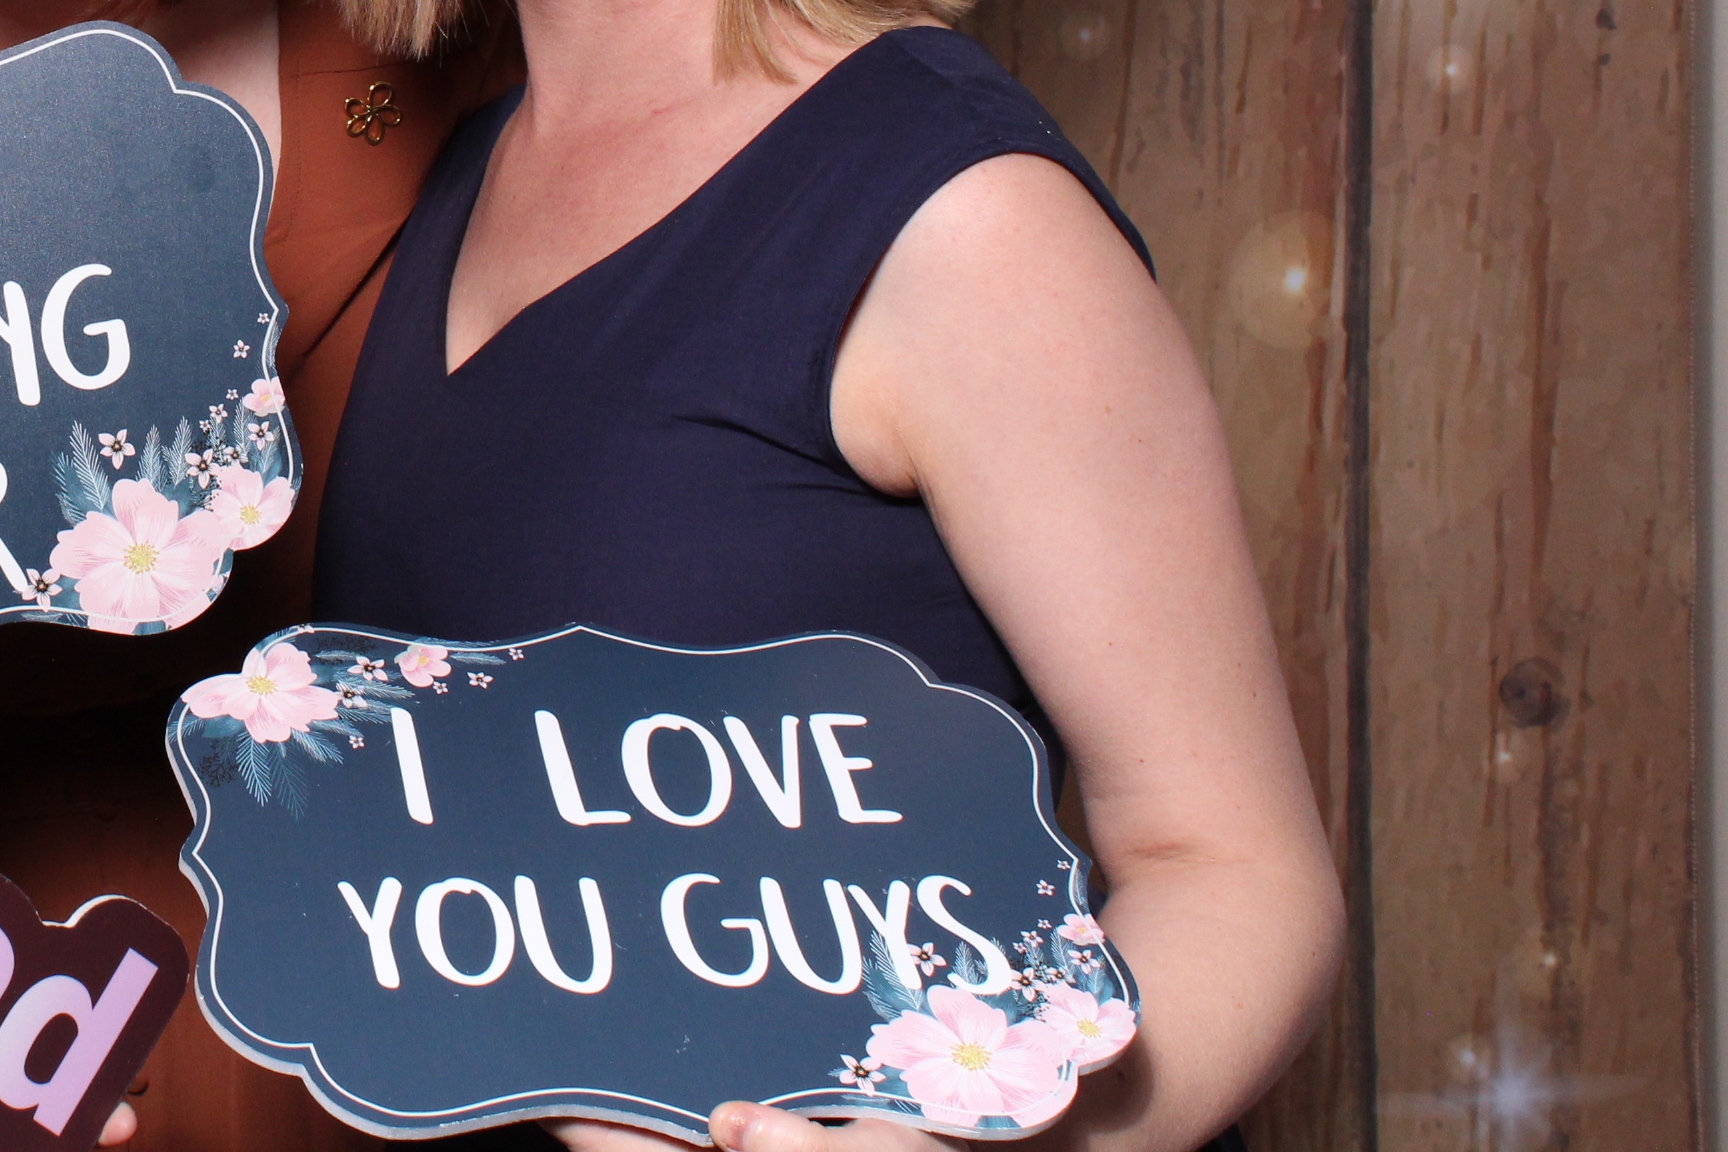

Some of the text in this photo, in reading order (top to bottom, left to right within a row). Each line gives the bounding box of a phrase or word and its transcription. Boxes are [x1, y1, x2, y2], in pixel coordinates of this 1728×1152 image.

[390, 707, 903, 829] I LOVE
[337, 873, 1013, 996] YOU GUYS
